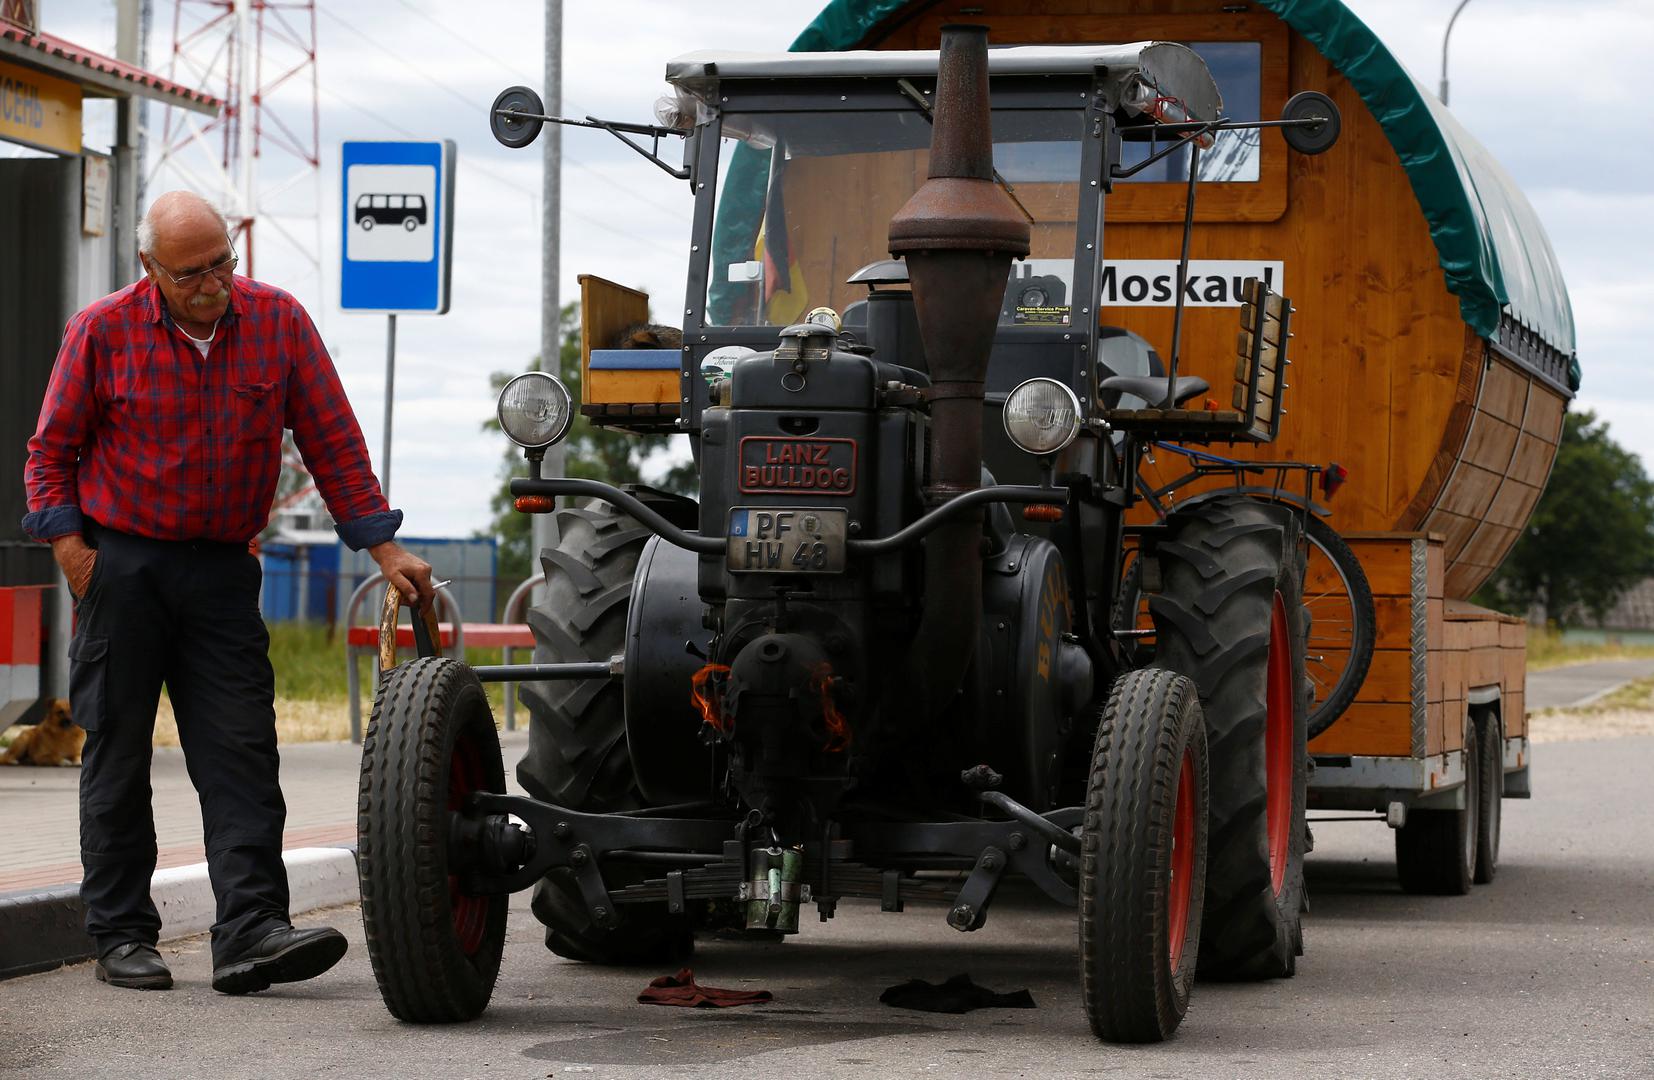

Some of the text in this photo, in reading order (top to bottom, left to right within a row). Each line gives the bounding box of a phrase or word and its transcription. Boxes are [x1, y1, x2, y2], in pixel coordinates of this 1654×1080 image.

[0, 76, 44, 129] СЕНЬ
[766, 443, 832, 465] LANZ
[745, 465, 849, 488] BULLDOG
[735, 526, 742, 535] D
[757, 511, 794, 539] PF
[745, 540, 828, 569] HW 48
